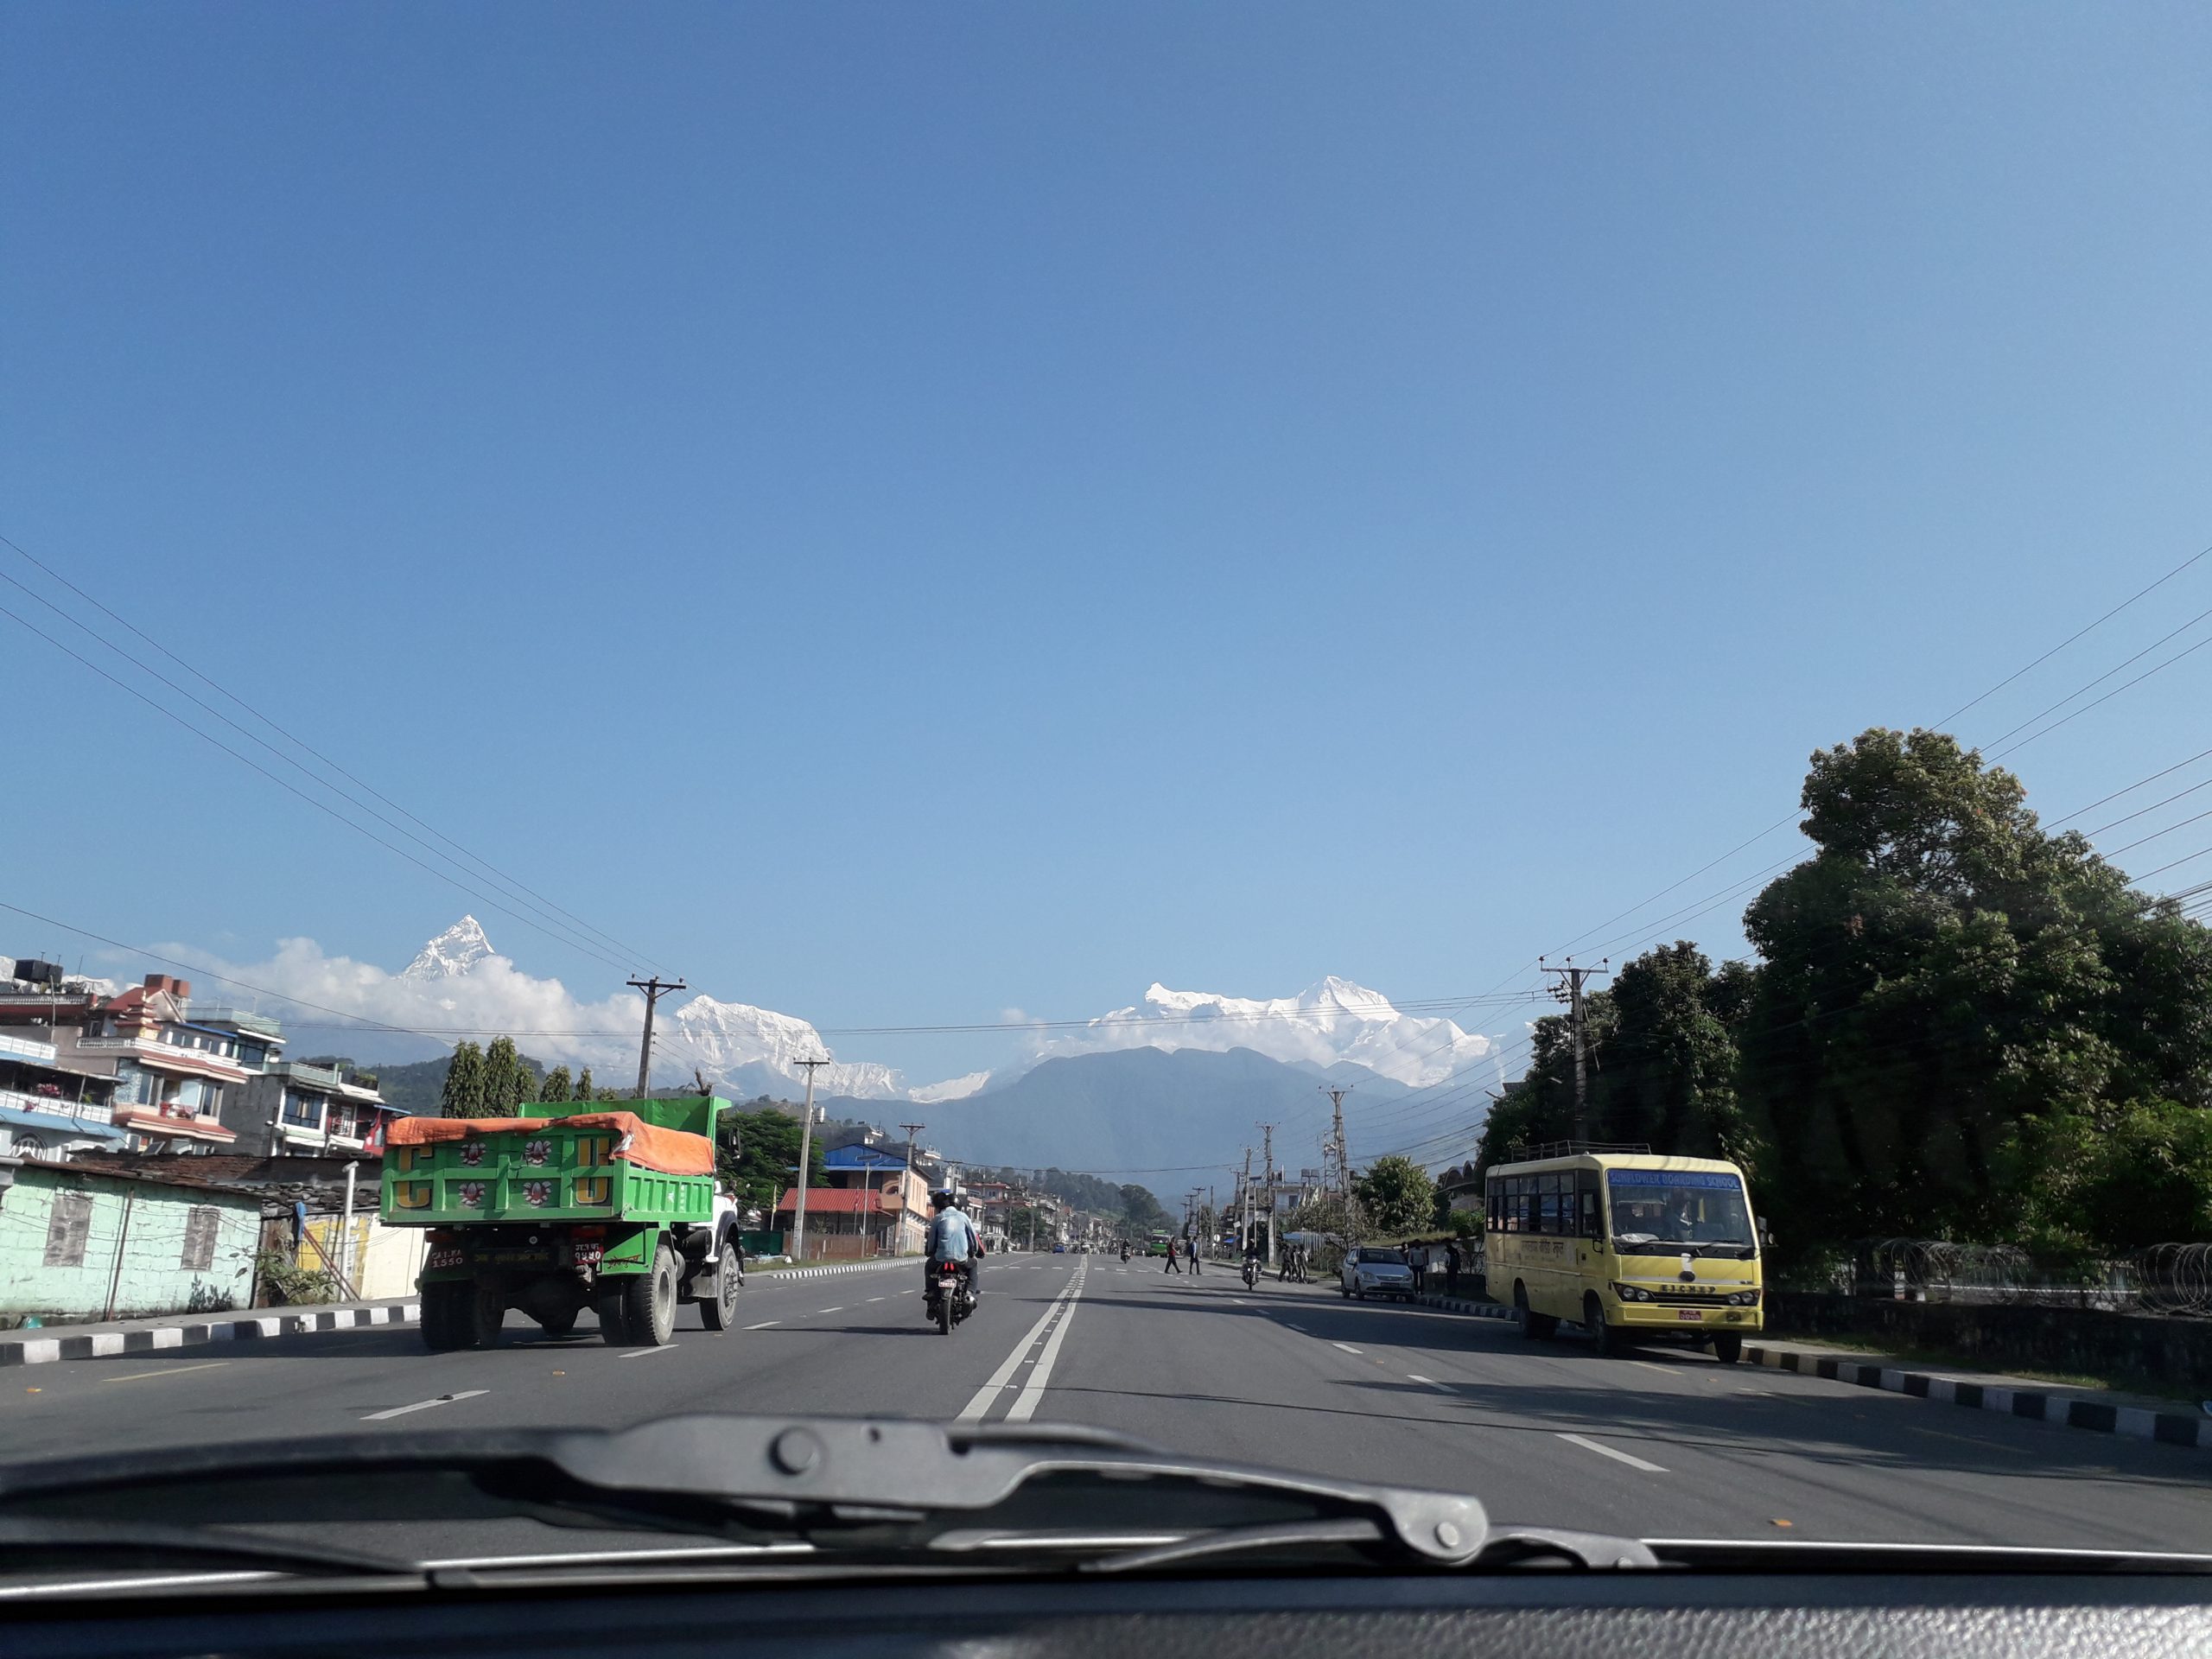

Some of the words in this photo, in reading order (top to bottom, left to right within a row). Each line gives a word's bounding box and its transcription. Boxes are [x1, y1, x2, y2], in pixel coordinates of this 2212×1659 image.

[397, 1147, 432, 1208] C
[575, 1138, 612, 1205] U
[1610, 1173, 1660, 1184] SUNFLOWER
[1662, 1173, 1706, 1186] BOARDING
[1707, 1176, 1739, 1189] SCHOOL
[432, 1257, 463, 1268] 1550
